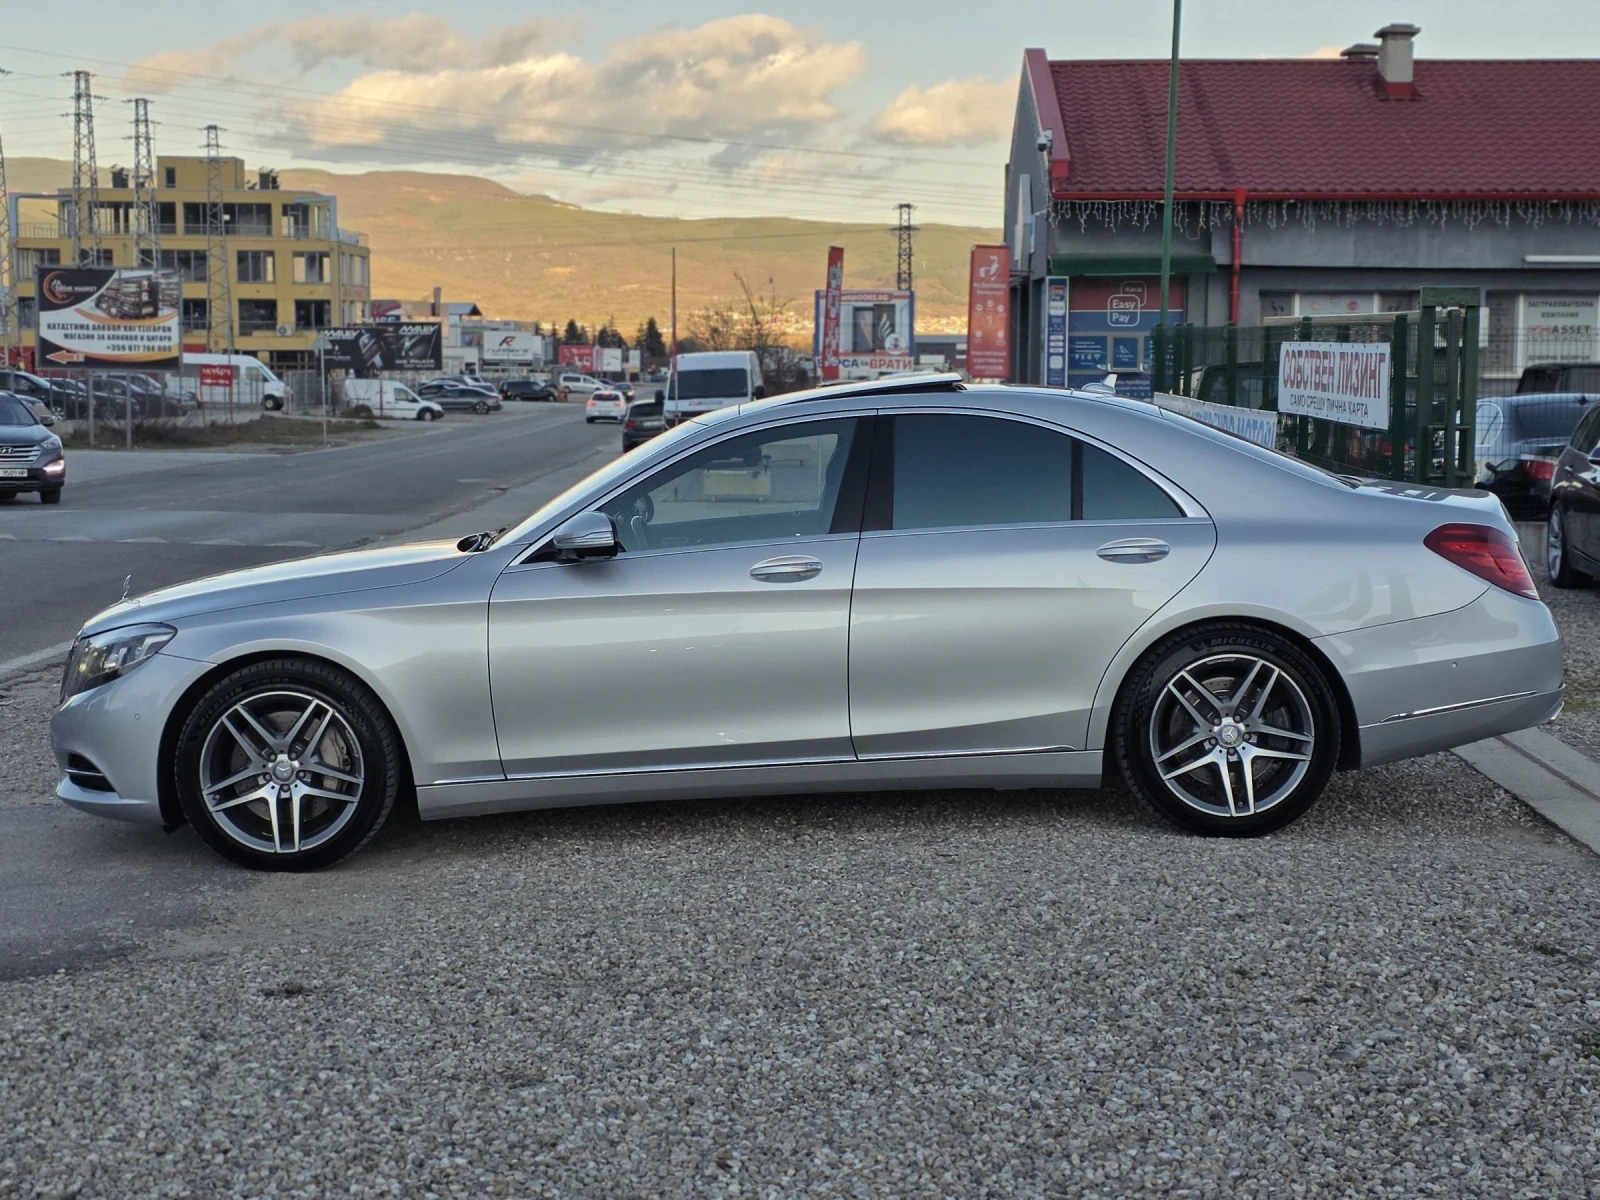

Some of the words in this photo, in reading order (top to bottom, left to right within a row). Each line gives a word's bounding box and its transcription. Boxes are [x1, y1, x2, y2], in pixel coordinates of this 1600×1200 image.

[1112, 300, 1136, 310] Easy
[1112, 312, 1130, 322] Pay
[1552, 325, 1591, 334] ASSET
[869, 358, 912, 370] ВРАТИ
[1282, 349, 1336, 394] СОБСТВЕН
[1336, 351, 1386, 399] ЛИЗИНГ
[1290, 393, 1305, 408] САМО
[1306, 395, 1325, 410] СРЕЩУ
[1326, 397, 1346, 414] ЛИЧНА
[1347, 401, 1368, 419] КАРТА
[1211, 637, 1276, 652] MICHELIN
